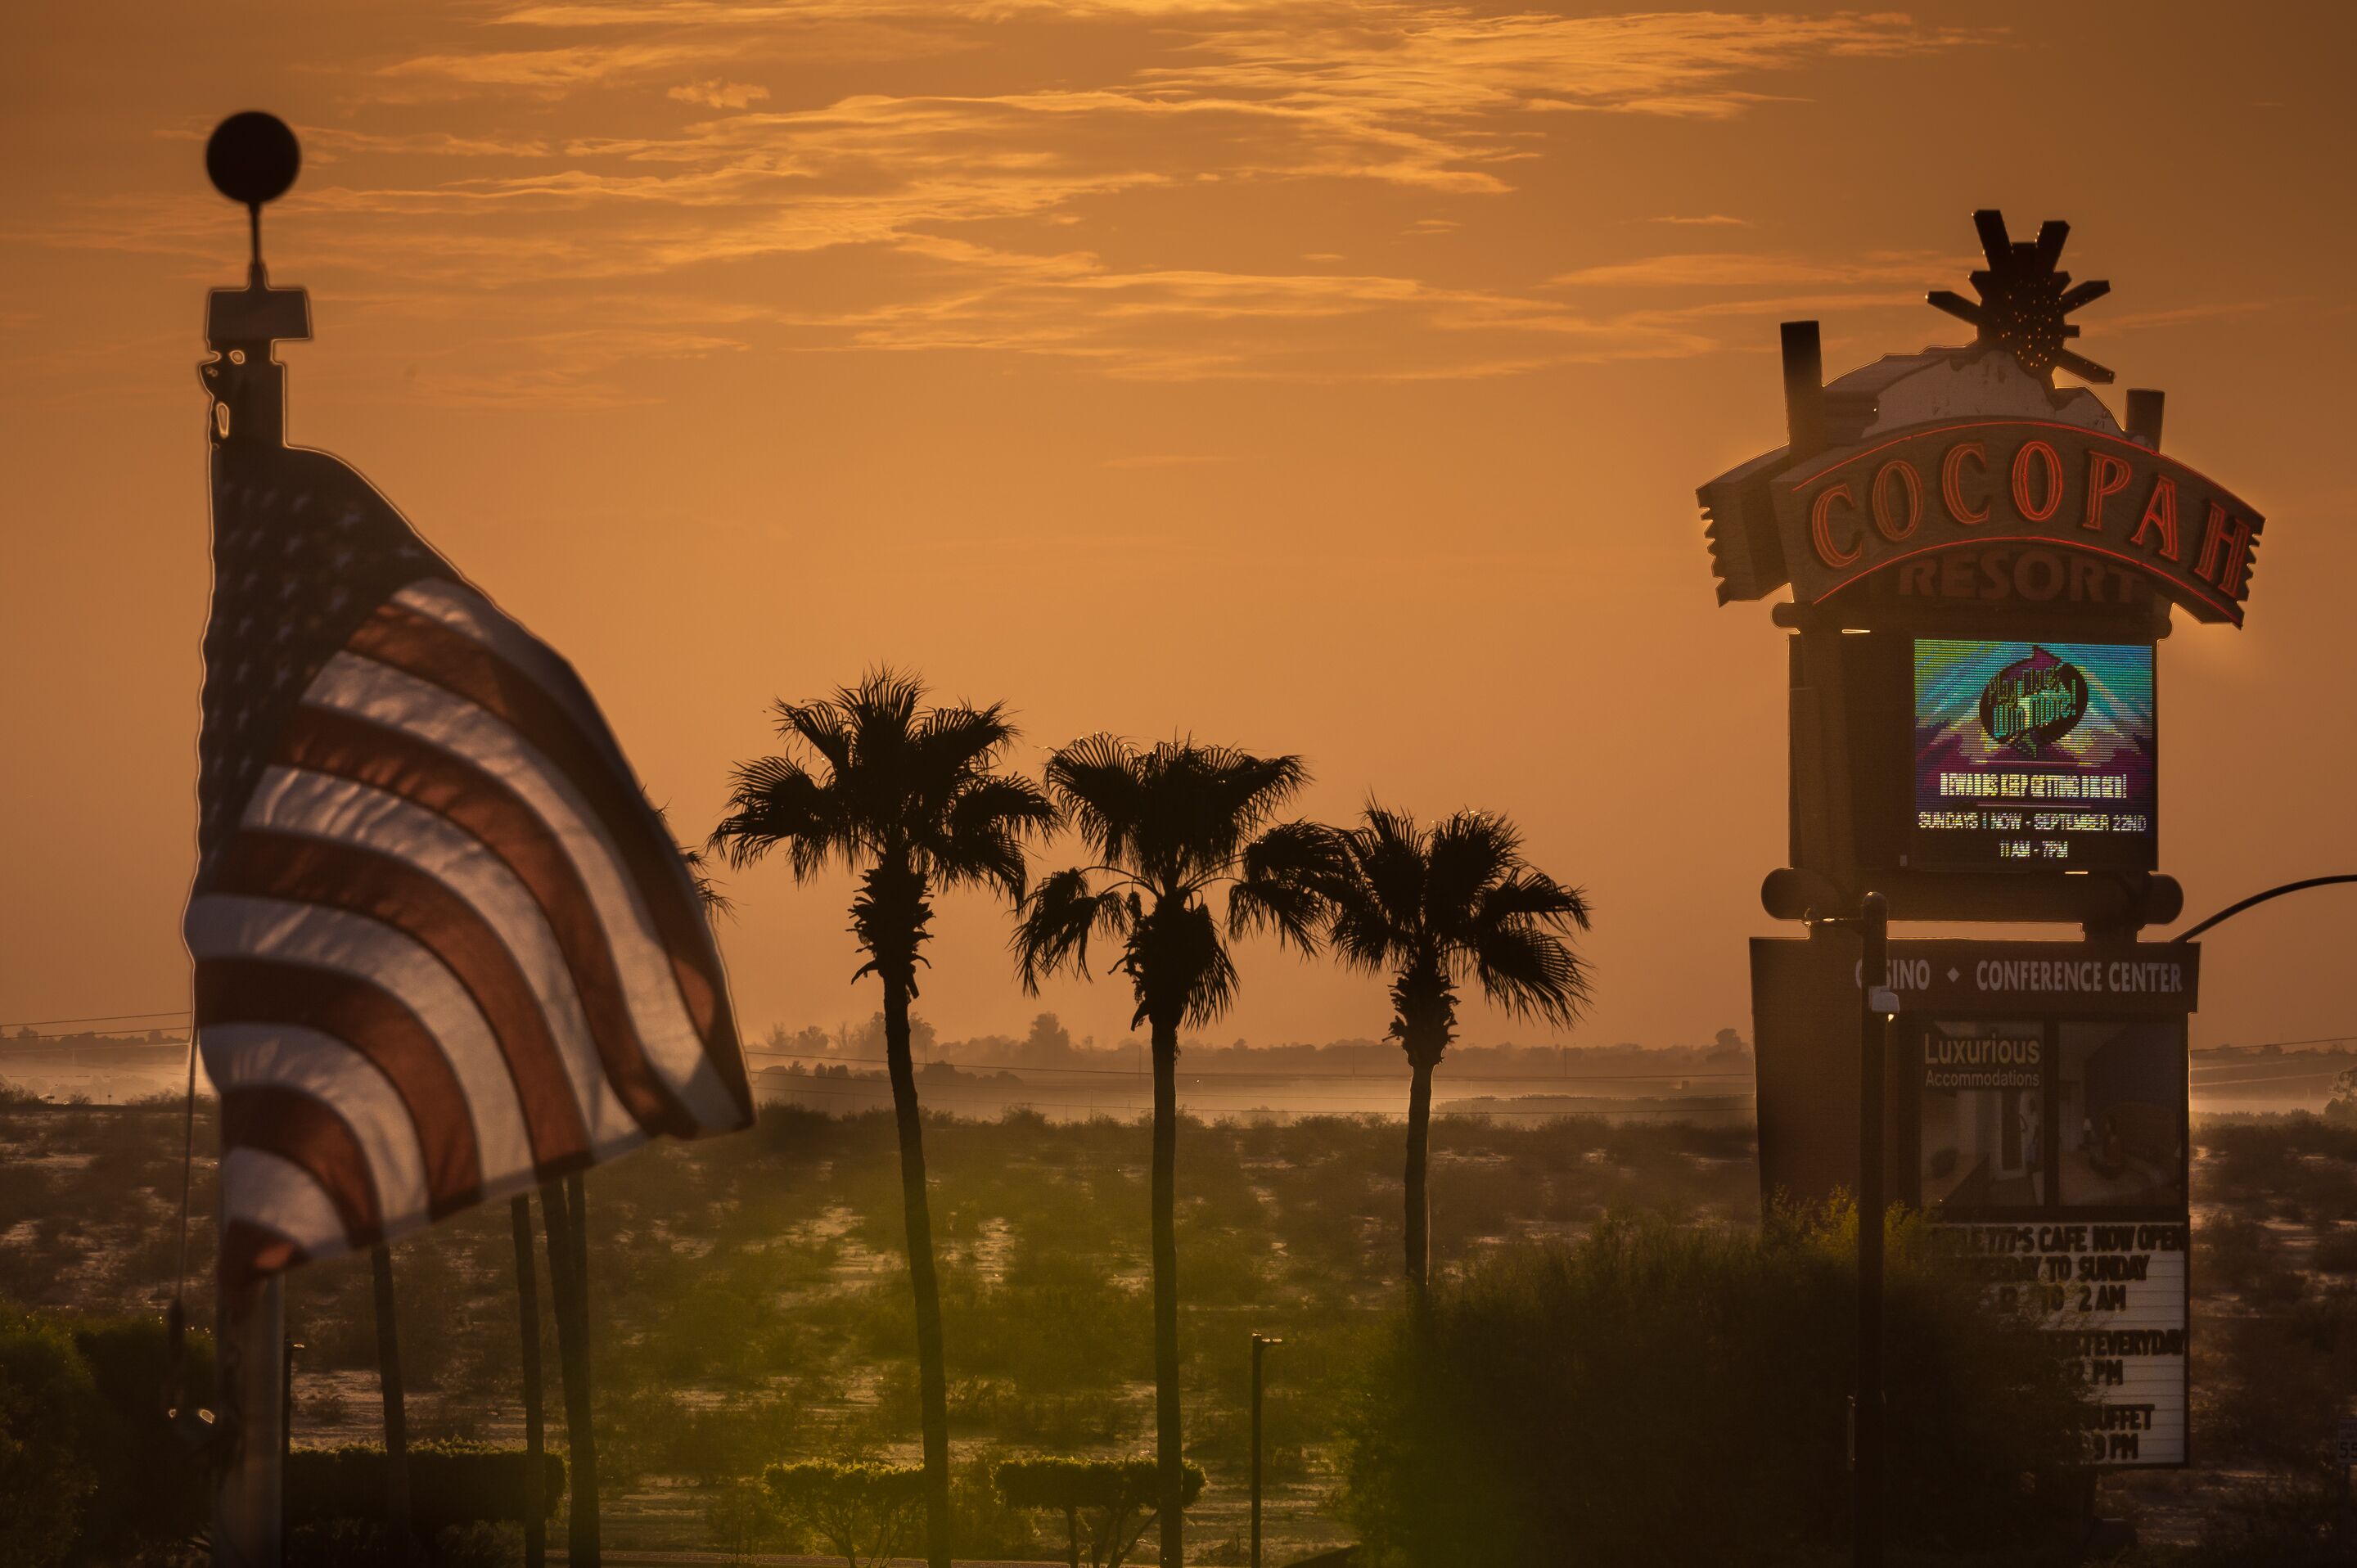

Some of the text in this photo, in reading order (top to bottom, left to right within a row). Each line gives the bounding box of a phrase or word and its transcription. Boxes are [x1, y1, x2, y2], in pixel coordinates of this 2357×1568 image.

[1810, 439, 2251, 600] COCOPAH
[1899, 547, 2144, 604] RESORT
[1918, 811, 1979, 829] SUNDAYS
[1990, 812, 2022, 830] NOW
[2034, 813, 2110, 831] SEPTEMBER
[2112, 814, 2147, 832] 22ND
[1855, 958, 2183, 994] CSINO CONFERENCE CENTER
[1924, 1032, 2041, 1066] Luxurious
[1925, 1068, 2040, 1088] Accommodations
[2039, 1225, 2088, 1253] CAFE
[2092, 1224, 2136, 1252] NOW
[2137, 1224, 2186, 1252] OPEN
[2046, 1255, 2072, 1282] TO
[2079, 1255, 2151, 1282] SUNDAY
[2079, 1284, 2092, 1311] 2
[2094, 1284, 2126, 1311] AM
[2093, 1359, 2123, 1386] PM
[2109, 1433, 2138, 1460] PM
